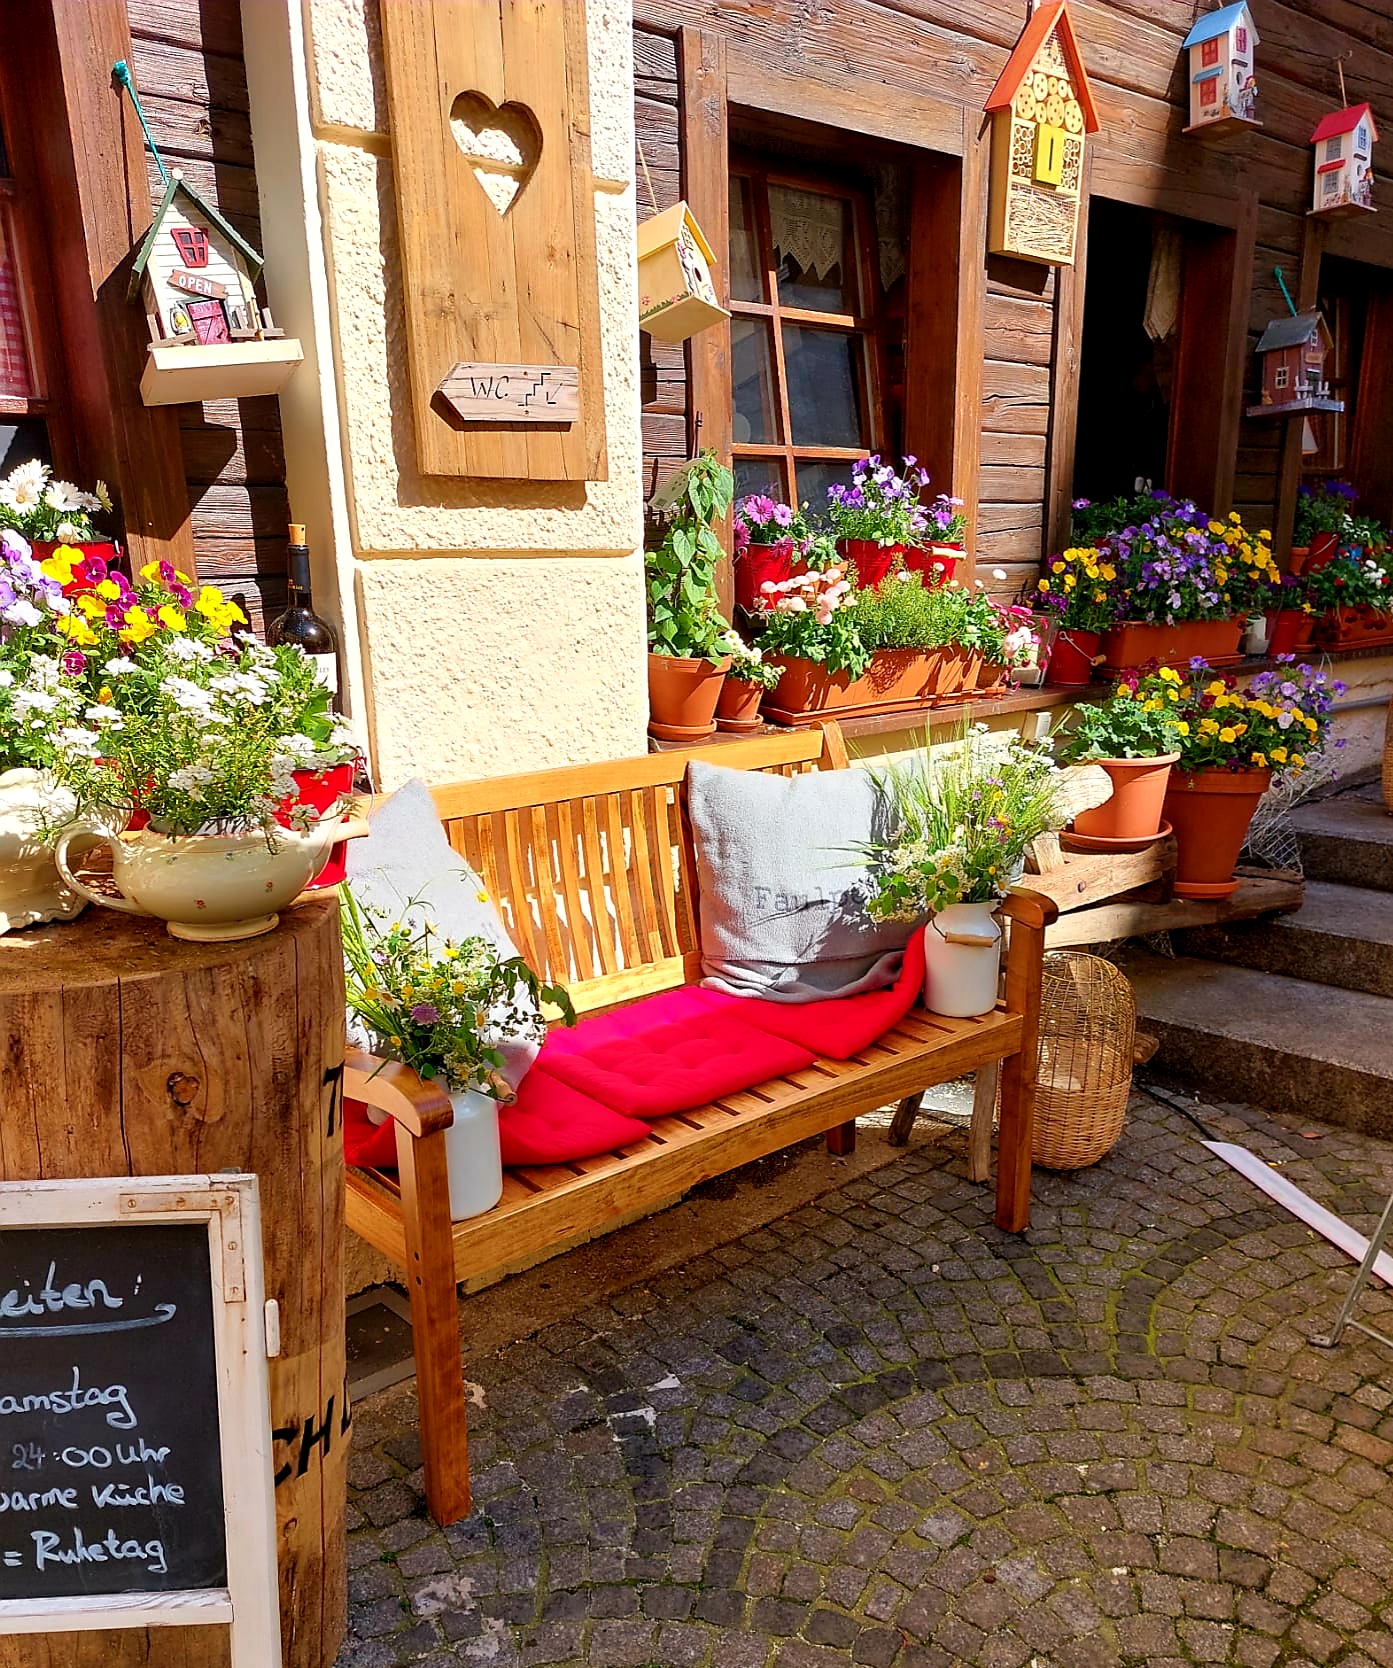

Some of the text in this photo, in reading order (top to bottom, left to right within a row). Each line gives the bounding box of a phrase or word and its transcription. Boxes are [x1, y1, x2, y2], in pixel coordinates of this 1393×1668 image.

[178, 275, 213, 295] OPEN
[470, 375, 509, 400] WC
[0, 1365, 139, 1430] amstag
[115, 1437, 172, 1466] Uhr
[91, 1473, 187, 1510] Küche
[30, 1525, 169, 1574] Ruhetag
